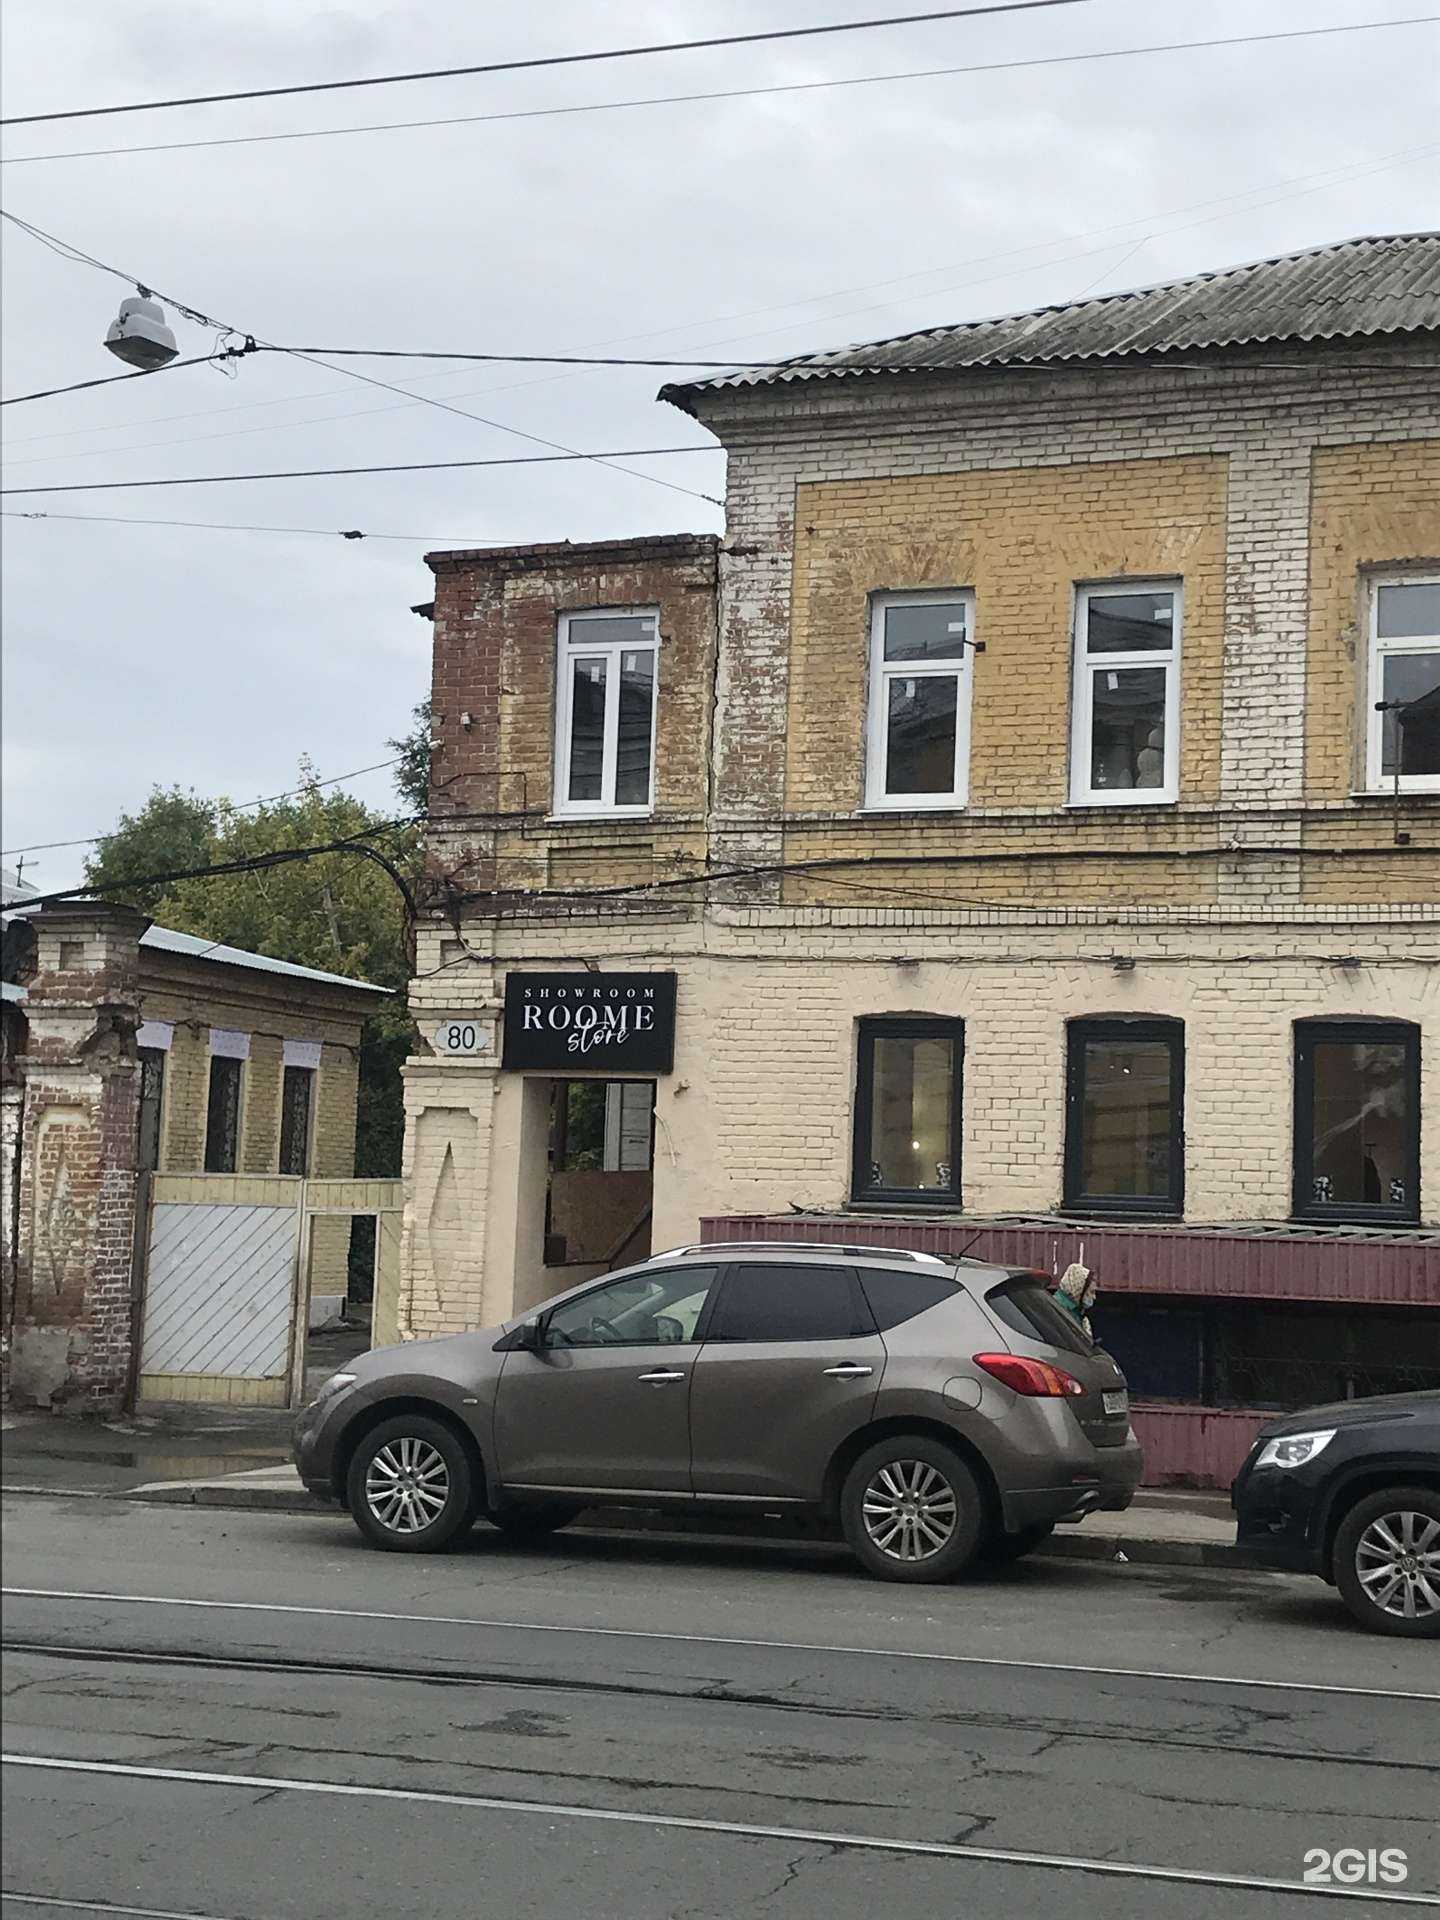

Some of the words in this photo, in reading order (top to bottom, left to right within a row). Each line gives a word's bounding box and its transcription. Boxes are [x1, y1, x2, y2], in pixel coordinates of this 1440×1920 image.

[524, 988, 655, 998] SHOWROOM
[522, 1004, 656, 1030] ROOME
[447, 1025, 476, 1049] 80
[566, 1018, 630, 1053] store
